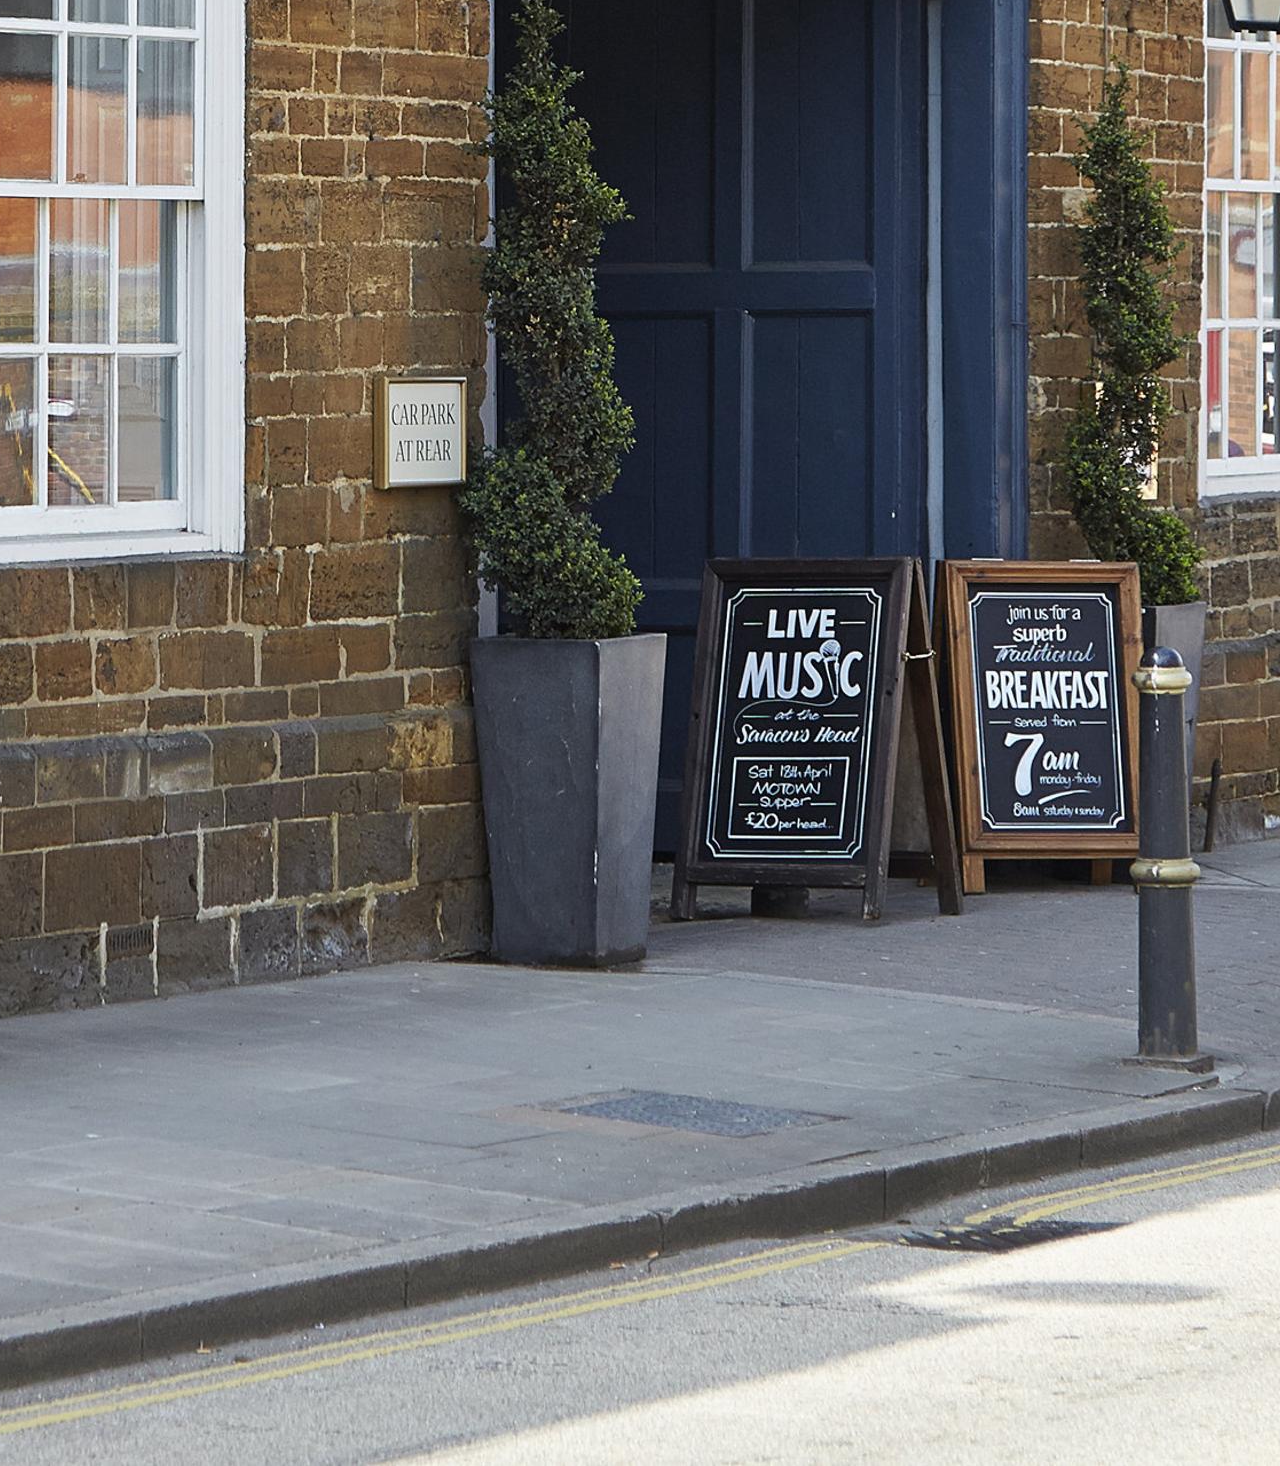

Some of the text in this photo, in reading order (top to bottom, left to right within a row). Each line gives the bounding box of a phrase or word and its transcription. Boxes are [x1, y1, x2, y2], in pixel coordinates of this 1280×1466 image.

[391, 403, 456, 426] CAR PARK
[395, 439, 451, 462] AT REAR
[767, 609, 836, 638] LIVE
[1006, 604, 1081, 625] join us for a
[1012, 623, 1067, 646] superb
[993, 641, 1096, 663] Traditional
[738, 639, 864, 699] MUSIC
[985, 670, 1109, 709] BREAKFAST
[774, 708, 820, 721] at the
[1051, 713, 1077, 727] from
[813, 725, 860, 743] Head
[748, 763, 832, 781] Sat 18th April
[752, 781, 821, 795] MOTOWN
[1013, 801, 1040, 817] 8am
[1079, 806, 1105, 818] sunday
[744, 811, 779, 829] £20
[779, 820, 796, 831] per
